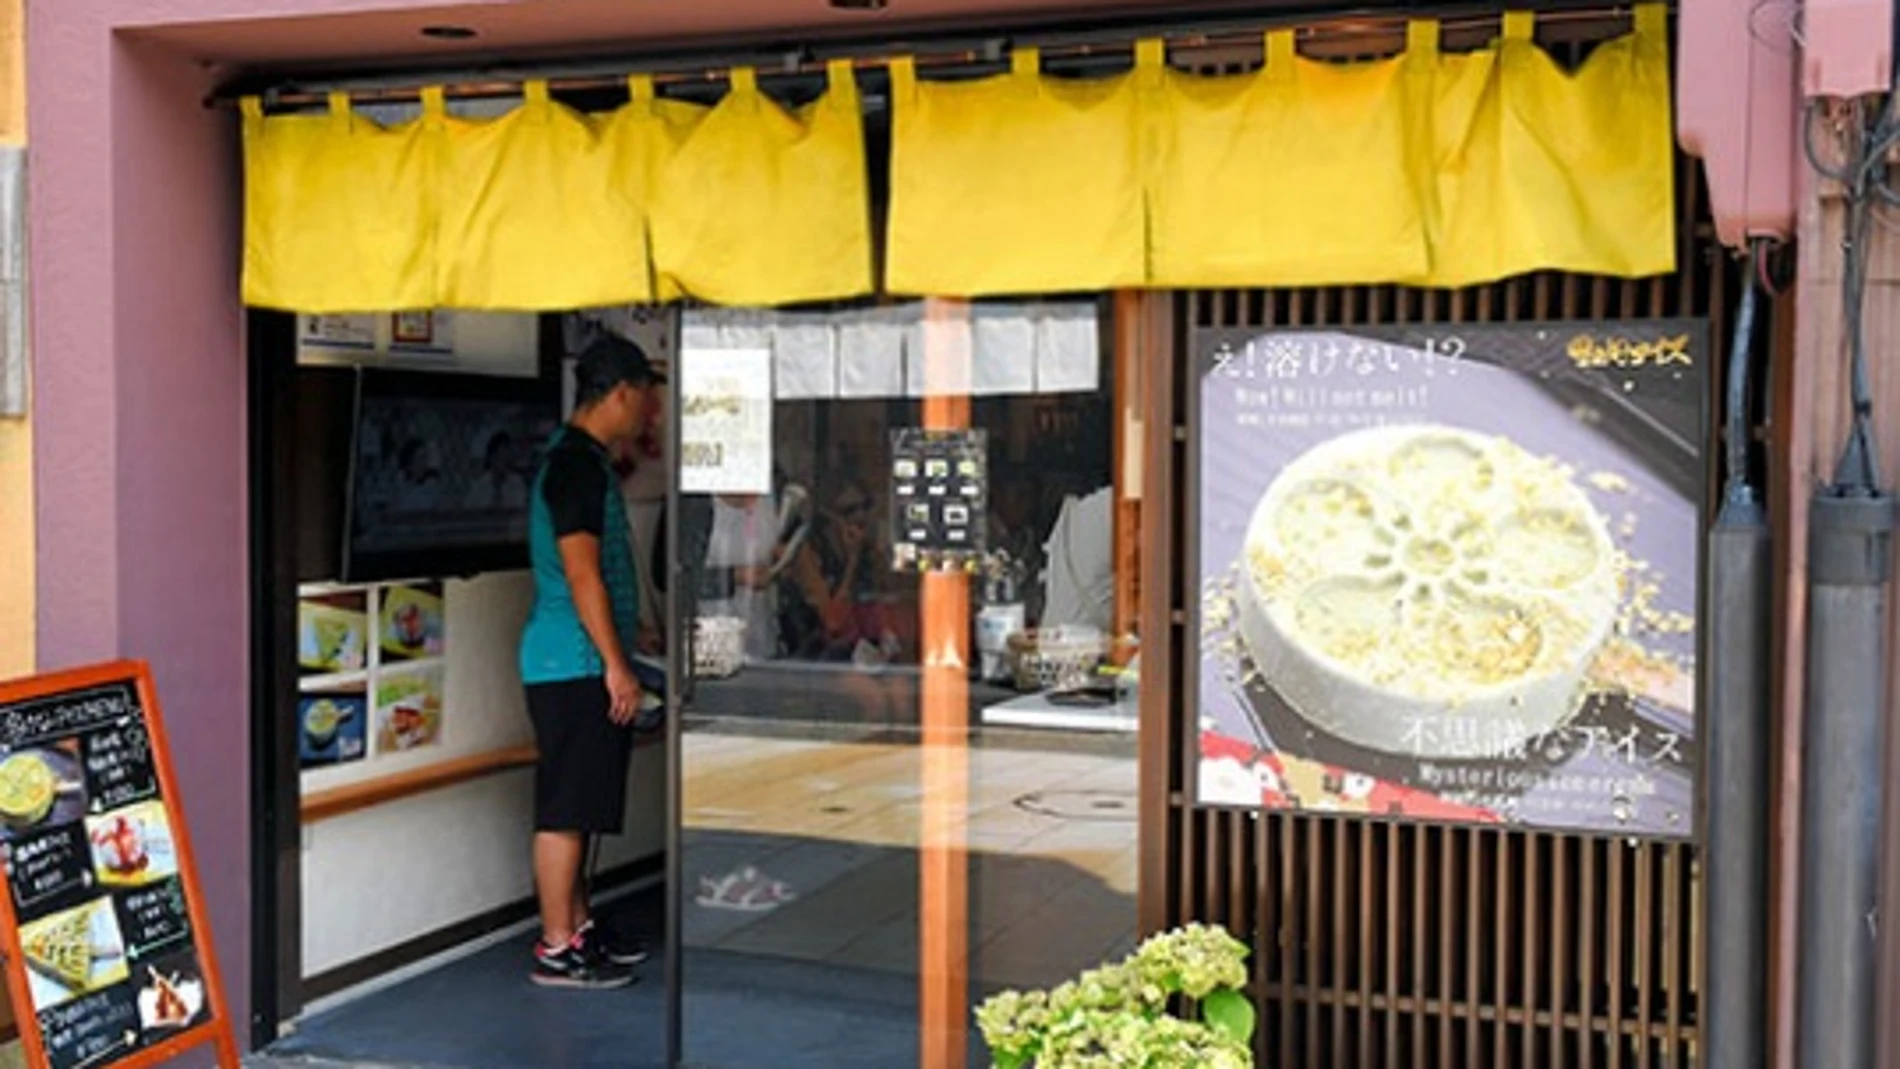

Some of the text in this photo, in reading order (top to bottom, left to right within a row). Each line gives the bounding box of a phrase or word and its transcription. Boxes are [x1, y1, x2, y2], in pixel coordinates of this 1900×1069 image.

[1401, 716, 1682, 764] 不思議なアイス
